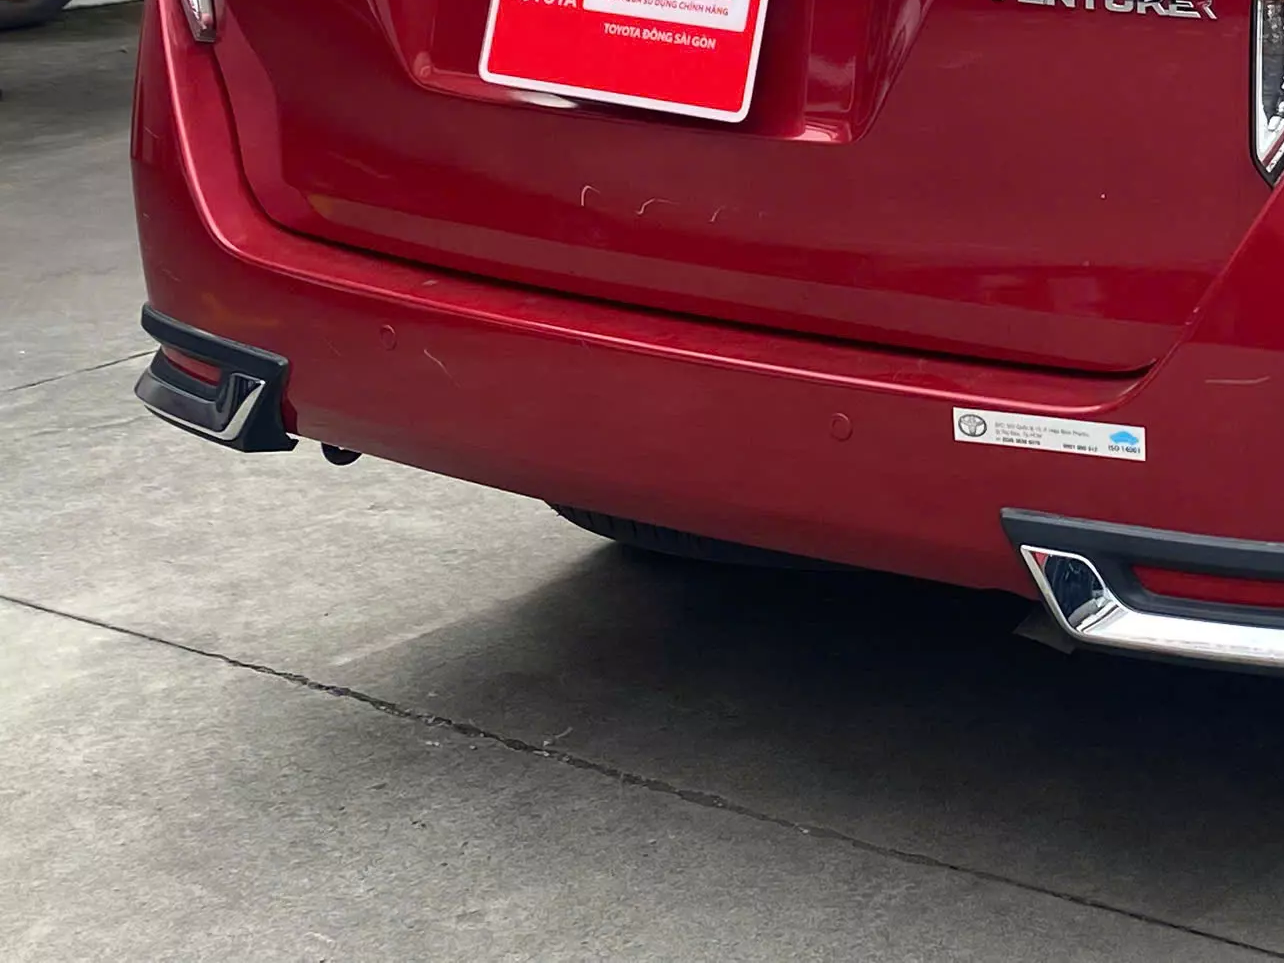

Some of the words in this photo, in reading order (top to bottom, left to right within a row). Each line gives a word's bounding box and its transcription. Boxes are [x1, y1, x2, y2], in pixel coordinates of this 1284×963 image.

[604, 22, 640, 39] TOYOTA
[642, 27, 673, 44] ĐÔNG
[674, 30, 691, 45] SÀI
[692, 33, 717, 49] GÒN
